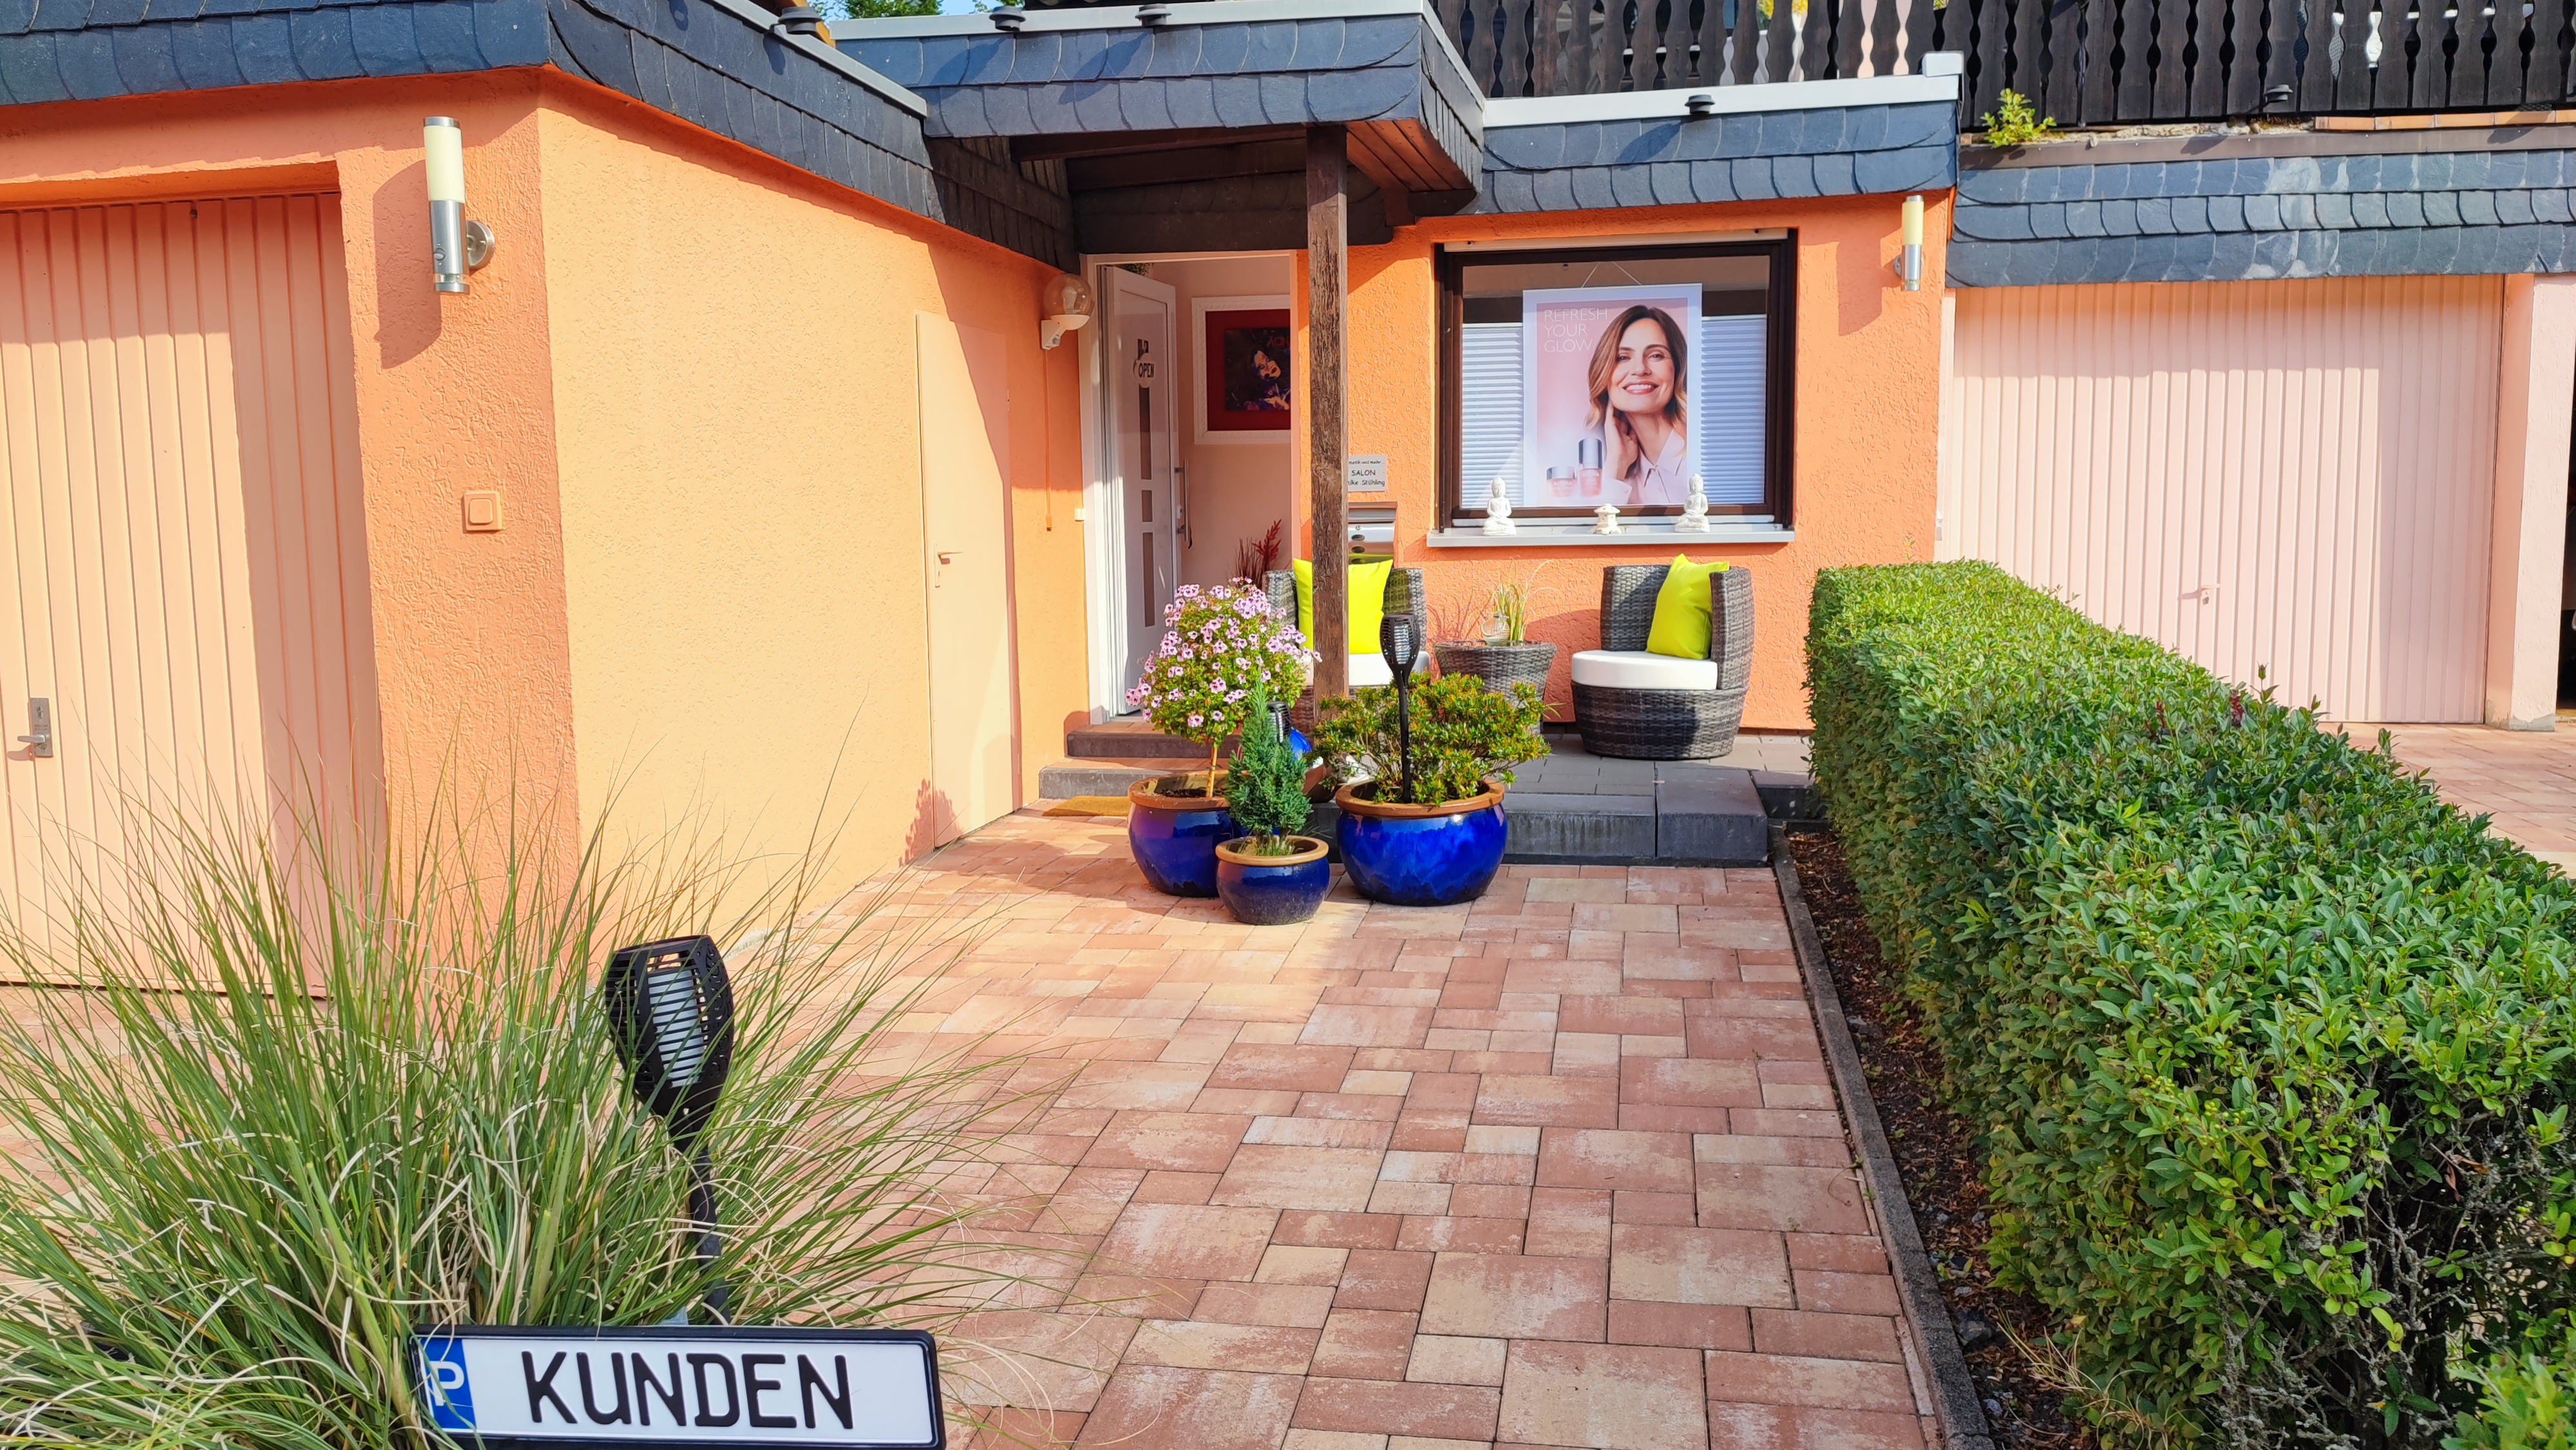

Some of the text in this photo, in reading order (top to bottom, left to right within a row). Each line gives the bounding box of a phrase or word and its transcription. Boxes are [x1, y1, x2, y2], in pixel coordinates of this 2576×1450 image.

[1544, 308, 1607, 321] REFRESH
[1544, 323, 1588, 337] YOUR
[1544, 339, 1593, 353] GLOW
[1138, 362, 1155, 378] OPEN
[426, 1350, 853, 1429] P KUNDEN
